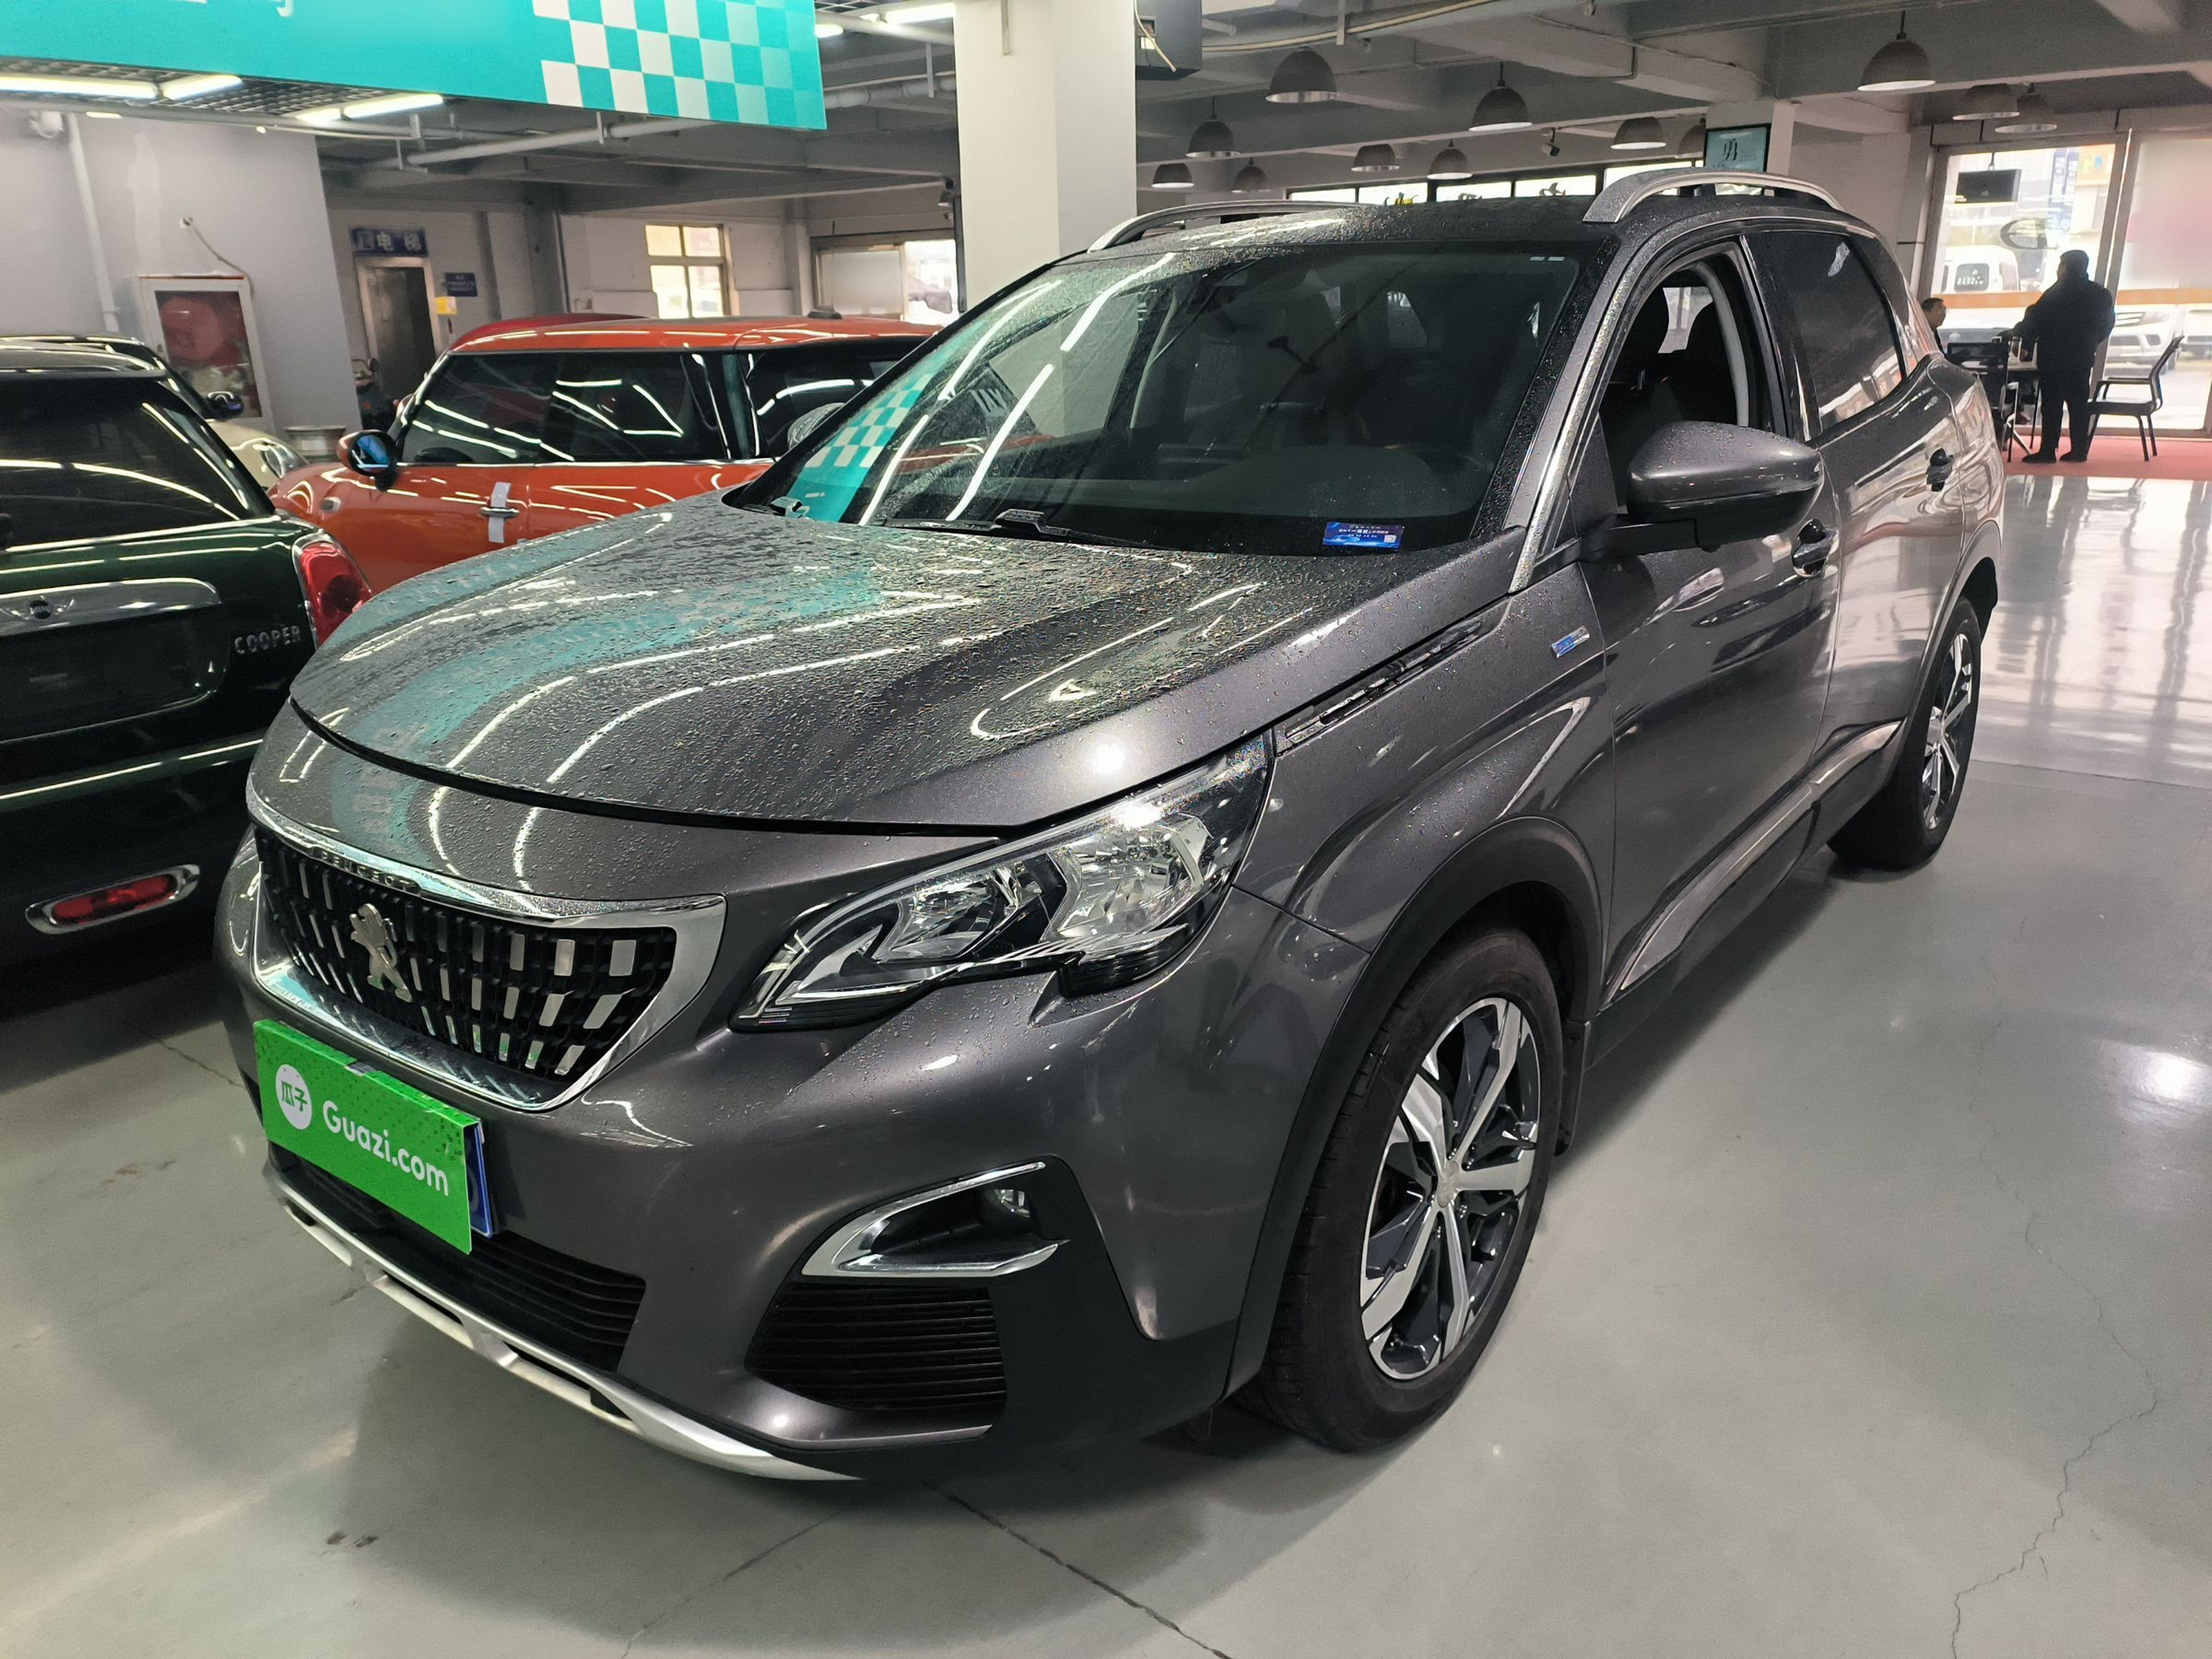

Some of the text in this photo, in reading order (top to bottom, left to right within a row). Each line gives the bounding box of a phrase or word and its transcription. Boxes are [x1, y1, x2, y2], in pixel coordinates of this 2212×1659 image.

[376, 232, 422, 251] 电梯
[234, 625, 300, 654] COOPER
[281, 1080, 308, 1112] 瓜子
[323, 1100, 449, 1196] Guazi.com
